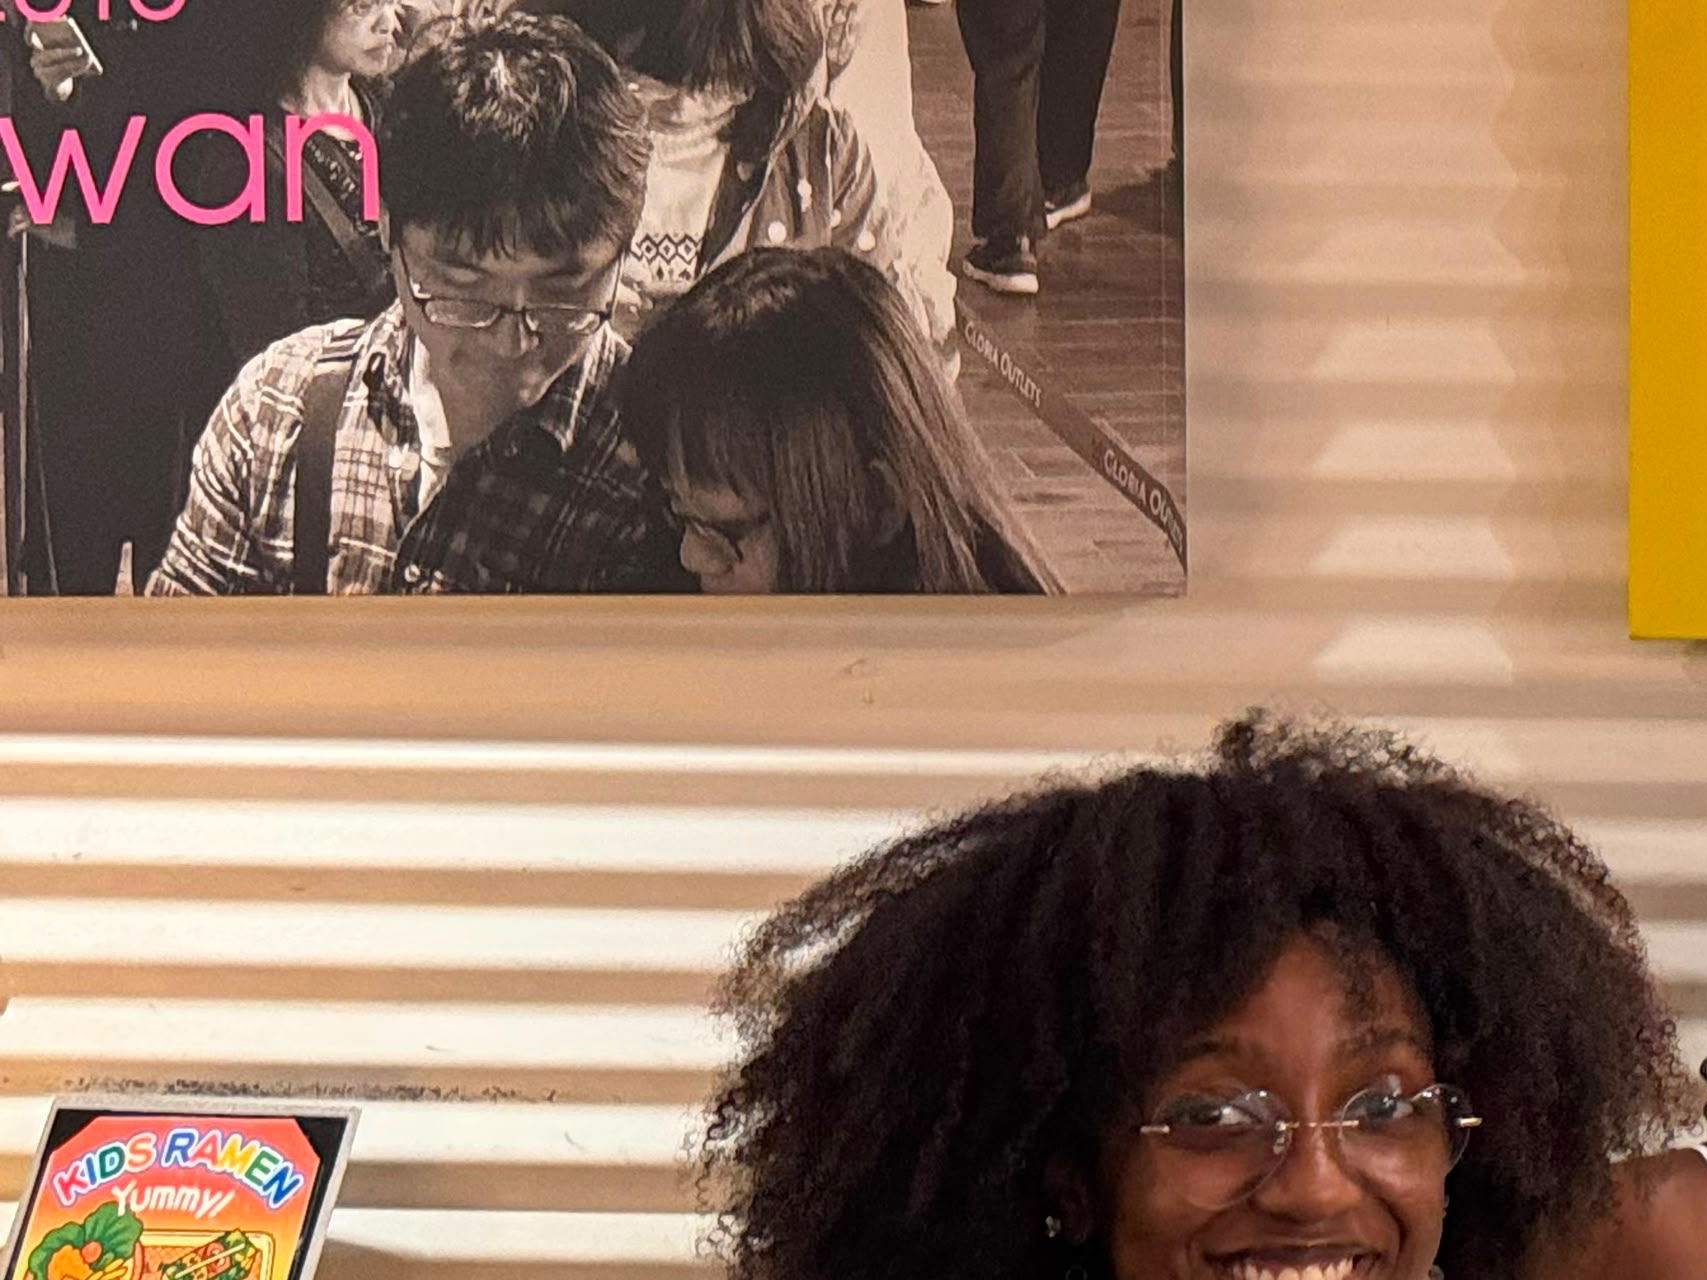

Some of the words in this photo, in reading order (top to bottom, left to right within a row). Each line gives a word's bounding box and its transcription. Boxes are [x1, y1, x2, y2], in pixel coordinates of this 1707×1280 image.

[999, 351, 1042, 408] OUTLETS
[53, 1131, 156, 1206] KIDS
[161, 1128, 304, 1209] RAMEN
